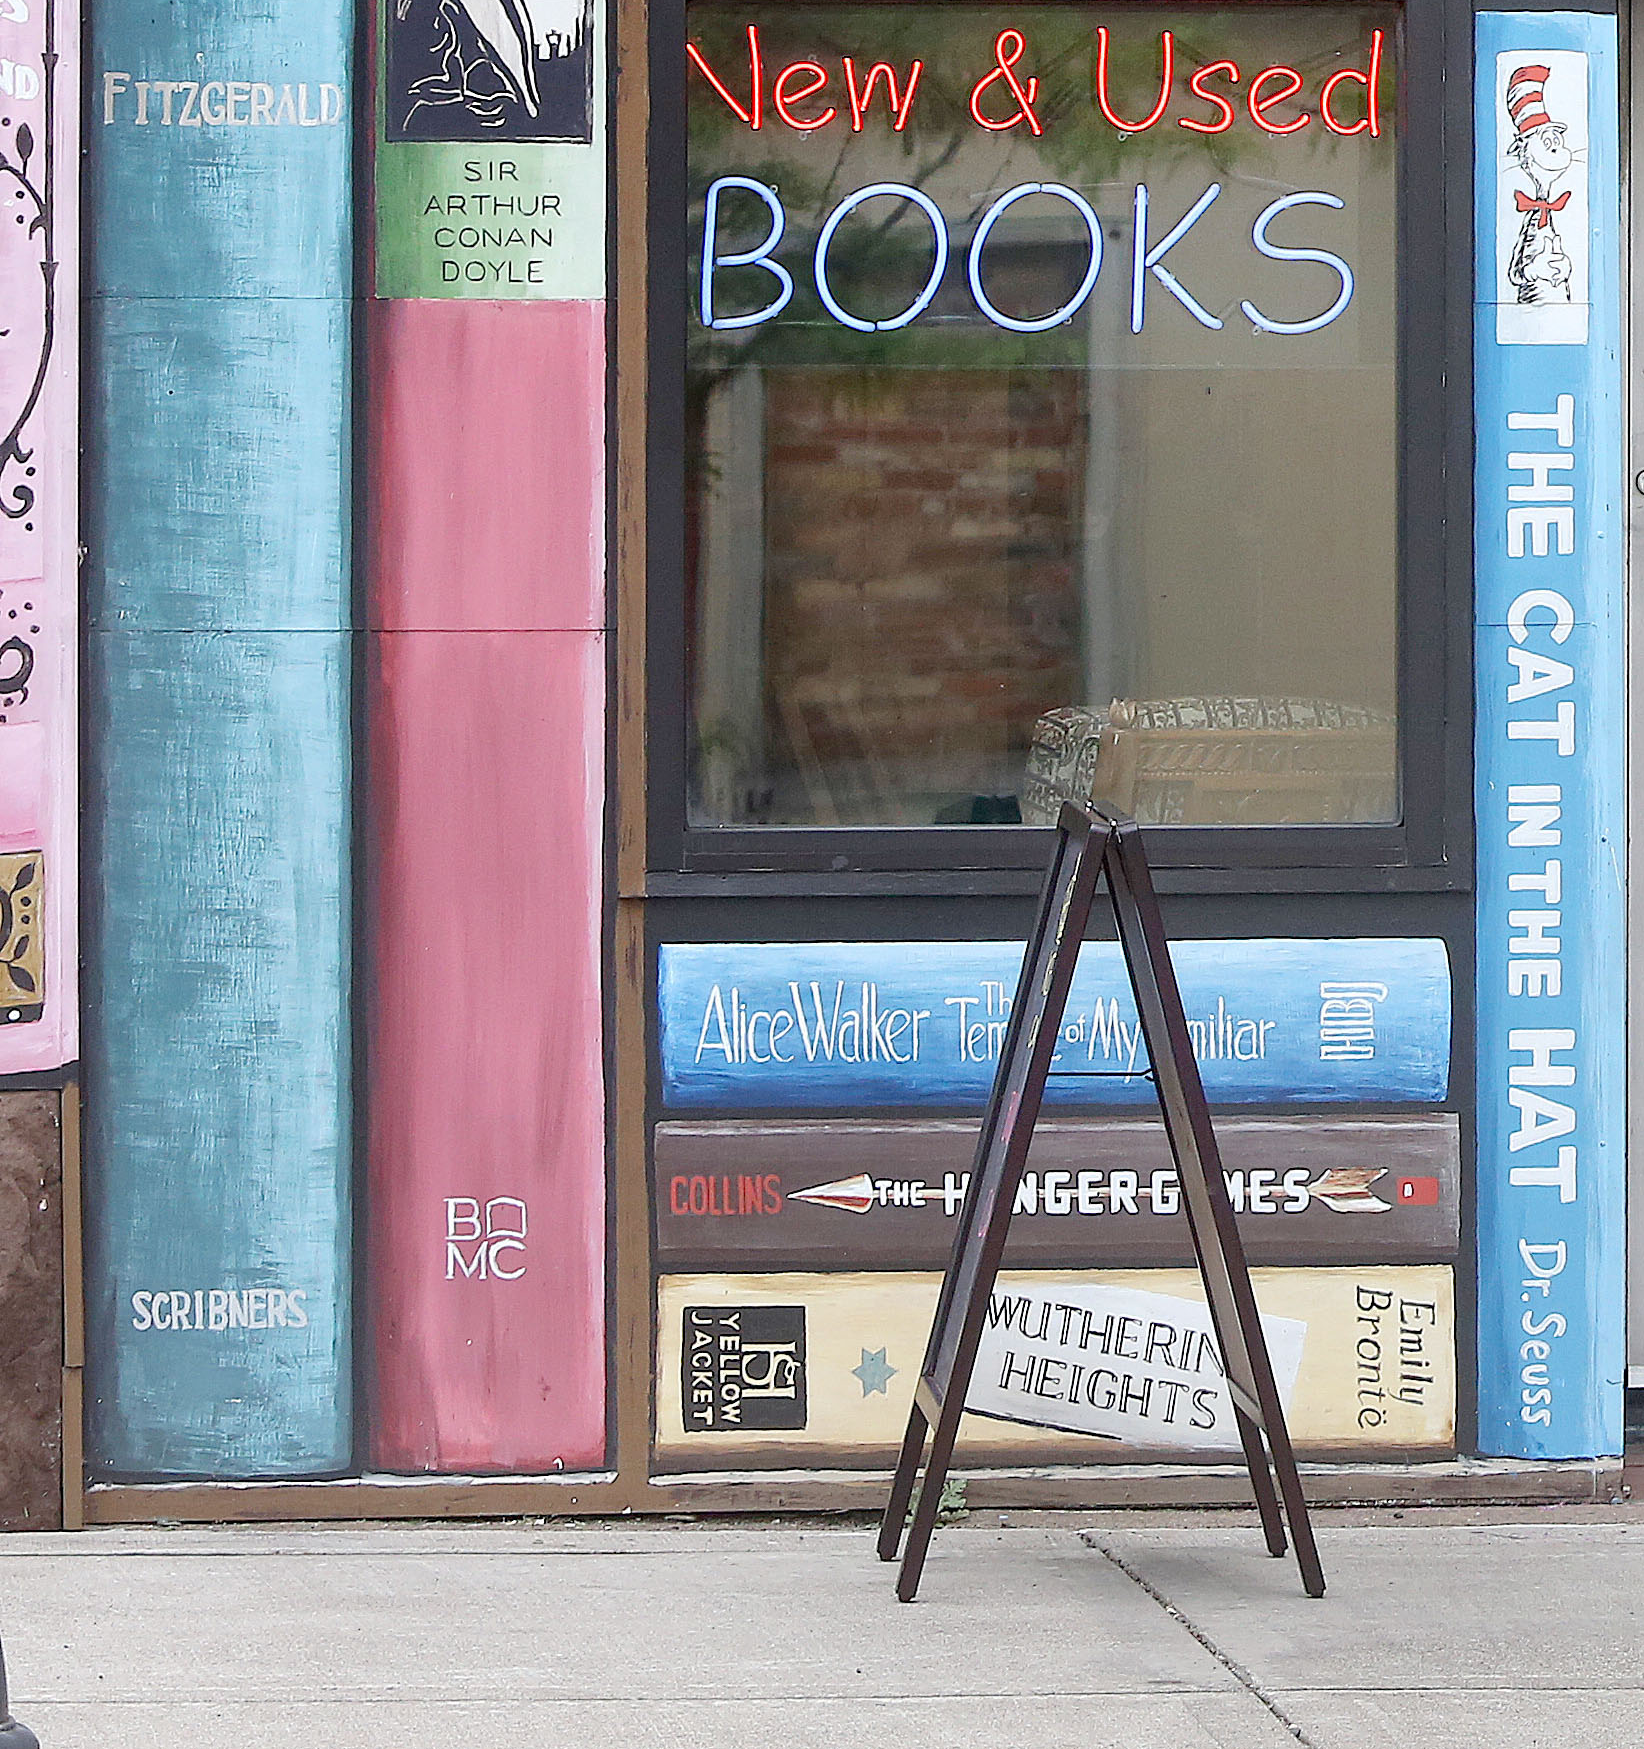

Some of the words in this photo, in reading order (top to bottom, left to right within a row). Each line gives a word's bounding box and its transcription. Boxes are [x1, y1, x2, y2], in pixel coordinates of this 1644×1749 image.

[103, 71, 344, 127] FITZGERALD
[686, 24, 922, 132] New
[969, 28, 1041, 135] &
[1097, 26, 1382, 137] Used
[423, 194, 562, 217] ARTHUR
[463, 160, 519, 182] SIR
[434, 227, 553, 249] CONAN
[441, 260, 545, 283] DOYLE
[700, 175, 1354, 335] BOOKS
[1506, 393, 1575, 559] THE
[1506, 587, 1576, 757] CAT
[1507, 784, 1562, 847] IN
[1507, 859, 1562, 998] THE
[694, 982, 793, 1065] Alice
[789, 980, 931, 1064] Walker
[1065, 1013, 1086, 1043] of
[1087, 995, 1143, 1084] My
[1507, 1028, 1577, 1204] HAT
[670, 1174, 782, 1217] COLLINS
[876, 1178, 927, 1208] THE
[943, 1170, 1139, 1215] HNGER
[1150, 1168, 1312, 1215] GMES
[132, 1288, 309, 1331] SCRIBNERS
[1517, 1238, 1568, 1303] Dr.
[691, 1310, 714, 1427] JACKET
[718, 1312, 742, 1424] YELLOW
[987, 1293, 1226, 1378] WUTHERIN
[1356, 1284, 1392, 1429] Brontë
[1398, 1298, 1437, 1408] Emily
[1518, 1309, 1568, 1427] Seuss
[999, 1350, 1219, 1429] HEIGHTS
